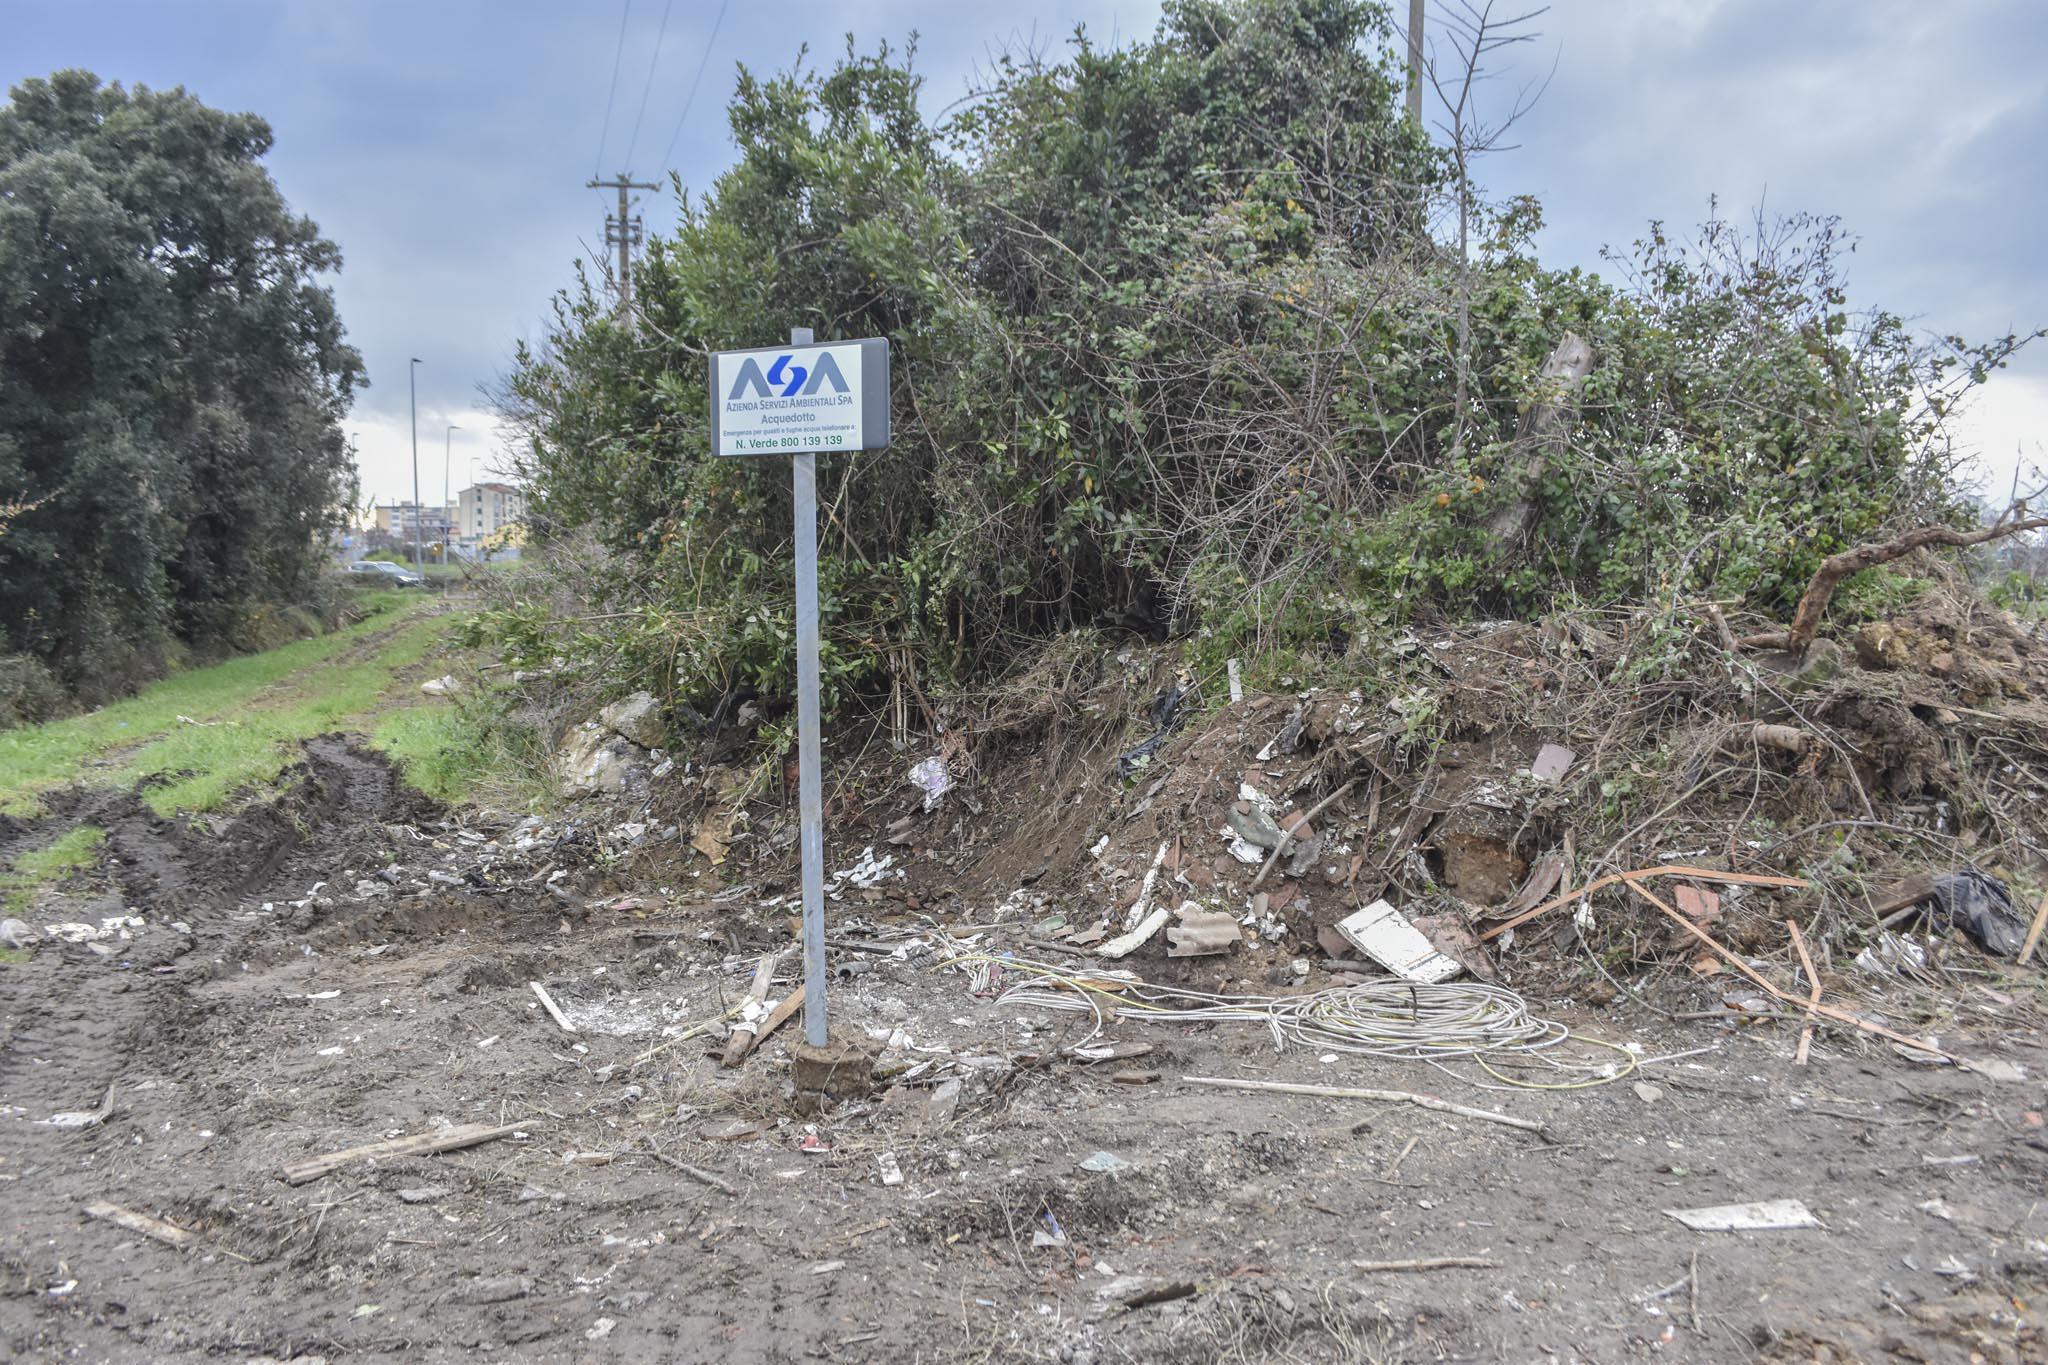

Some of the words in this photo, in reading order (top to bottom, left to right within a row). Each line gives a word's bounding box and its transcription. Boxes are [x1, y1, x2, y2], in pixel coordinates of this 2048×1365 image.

[761, 412, 816, 426] Acquedotto
[736, 439, 746, 449] N.
[749, 438, 778, 449] Verde
[781, 437, 799, 447] 800
[803, 436, 821, 446] 139
[825, 435, 843, 445] 139
